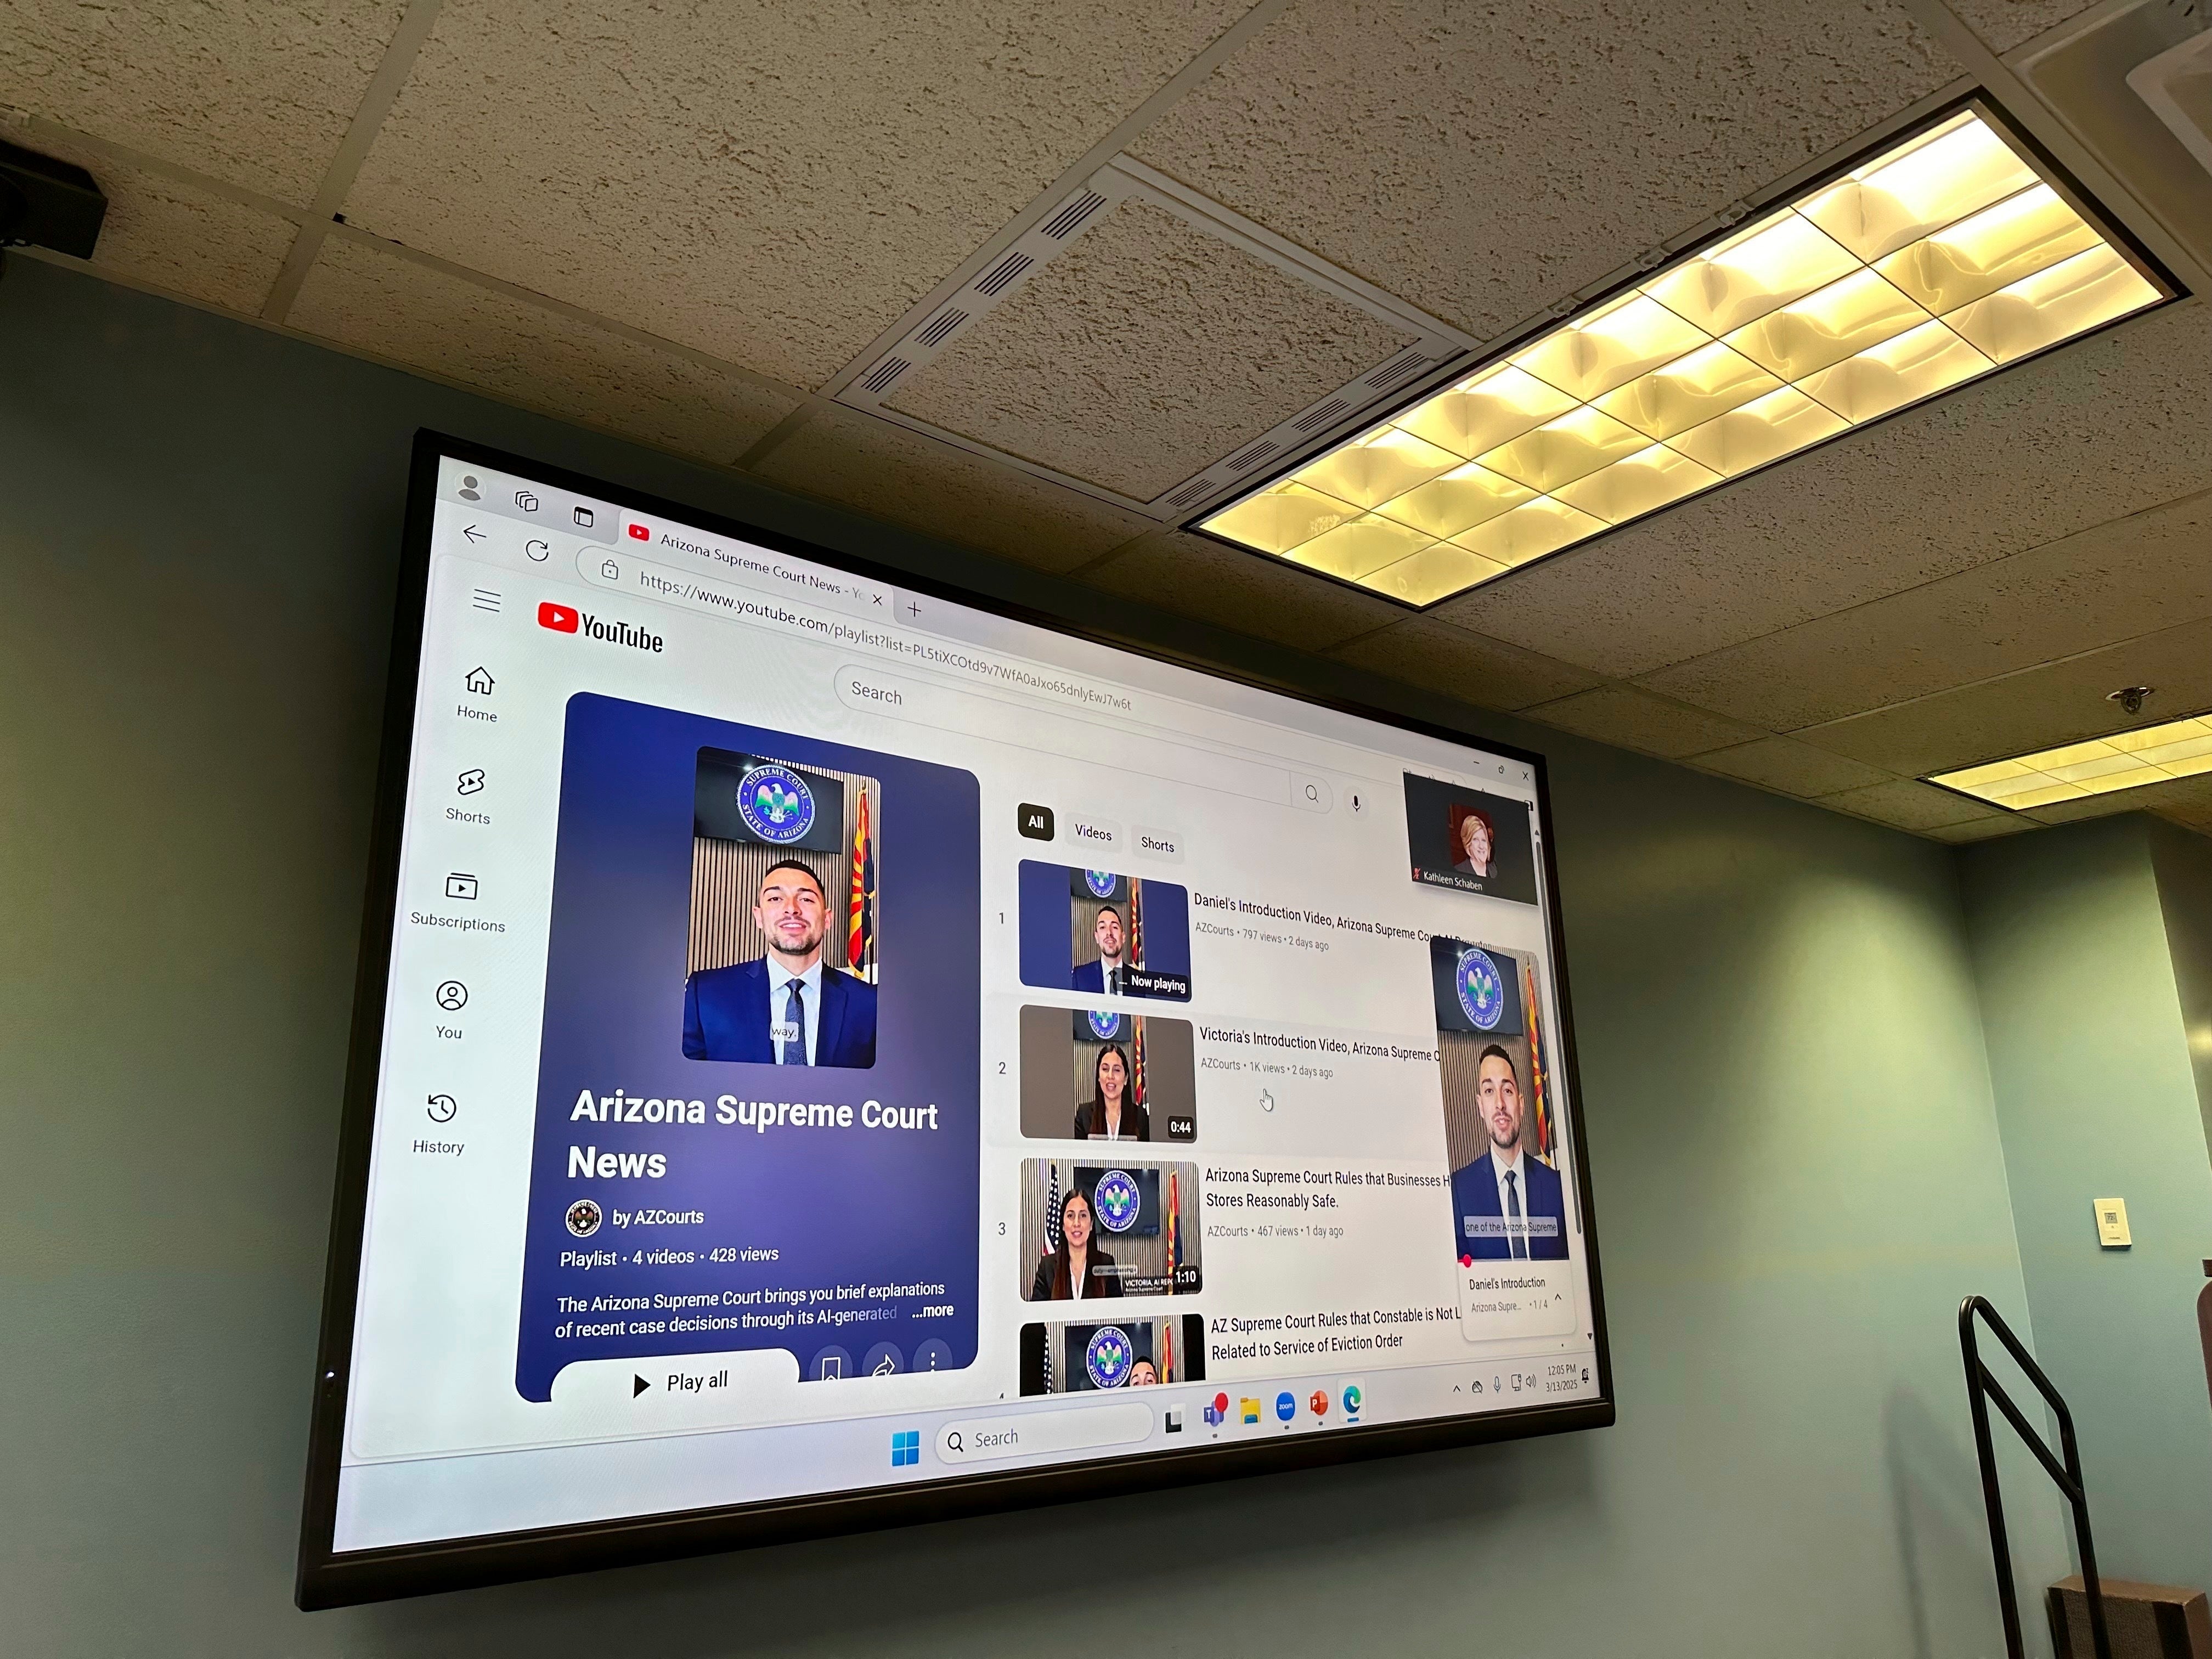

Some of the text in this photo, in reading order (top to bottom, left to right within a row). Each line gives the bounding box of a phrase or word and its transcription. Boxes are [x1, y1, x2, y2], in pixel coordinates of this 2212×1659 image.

[661, 534, 710, 557] Arizona
[715, 549, 769, 574] Supreme
[773, 566, 806, 585] Court
[810, 575, 840, 595] News
[582, 612, 663, 653] YouTube
[852, 681, 902, 706] Search
[457, 704, 498, 723] Home
[746, 768, 809, 800] SUPREME COURT
[445, 808, 490, 825] Shorts
[742, 804, 809, 839] STATE OF ARIZONA
[1028, 815, 1044, 829] All
[1075, 823, 1112, 841] Videos
[1141, 837, 1175, 853] Shorts
[1424, 871, 1483, 891] Kathleen Schaben
[410, 912, 506, 933] Subscriptions
[999, 912, 1005, 924] 1
[1194, 893, 1236, 911] Daniel's
[1239, 900, 1301, 922] Introduction
[1304, 911, 1334, 929] Video,
[1337, 917, 1373, 933] Arizona
[1375, 923, 1415, 941] Supreme
[1195, 922, 1329, 952] AZCourts 797 views 2 days ago
[1460, 952, 1498, 982] SUPREME COURT
[1131, 975, 1186, 994] Now playing
[1460, 991, 1501, 1024] STATE OF ARIZONA
[436, 1025, 462, 1039] You
[771, 1029, 796, 1039] way.
[1199, 1026, 1250, 1045] Victoria's
[1254, 1031, 1316, 1051] Introduction
[1319, 1039, 1350, 1054] Video,
[1352, 1043, 1389, 1057] Arizona
[1391, 1046, 1432, 1062] Supreme
[998, 1062, 1006, 1074] 2
[1201, 1058, 1334, 1079] AZCourts 1K views 2 days ago
[569, 1089, 939, 1133] Arizona Supreme Court
[1171, 1121, 1191, 1133] 0:44
[413, 1140, 465, 1156] History
[567, 1146, 667, 1178] News
[1206, 1168, 1249, 1182] Arizona
[1252, 1170, 1301, 1186] Supreme
[1304, 1171, 1333, 1184] Court
[1335, 1171, 1363, 1185] Rules
[1365, 1172, 1386, 1186] that
[1387, 1173, 1441, 1187] Businesses
[1206, 1193, 1339, 1210] Stores Reasonably Safe.
[613, 1209, 631, 1229] by
[634, 1210, 704, 1225] AZCourts
[998, 1222, 1006, 1235] 3
[1465, 1222, 1556, 1234] one of the Arizona Supreme
[1207, 1224, 1344, 1239] AZCourts 467 views 1 day ago
[560, 1246, 780, 1271] Playlist 4 videos 428 views
[1176, 1271, 1197, 1283] 1:10
[1469, 1277, 1545, 1290] Daniel's Introduction
[557, 1282, 945, 1313] The Arizona Supreme Court brings you brief explanations
[912, 1304, 955, 1318] ...more
[1471, 1302, 1497, 1313] Arizona
[555, 1305, 898, 1338] of recent case decisions through its AI-generated
[1211, 1319, 1228, 1333] AZ
[1231, 1317, 1282, 1335] Supreme
[1285, 1314, 1315, 1329] Court
[1318, 1313, 1347, 1327] Rules
[1350, 1311, 1371, 1325] that
[1374, 1308, 1423, 1323] Constable
[1425, 1308, 1434, 1320] is
[1436, 1306, 1454, 1320] Not
[1212, 1334, 1403, 1360] Related to Service of Eviction Order
[1548, 1364, 1576, 1375] 12:05 PM
[667, 1371, 728, 1393] Play all
[1546, 1380, 1578, 1392] 3/13/2025
[1312, 1399, 1318, 1408] P
[975, 1428, 1018, 1447] Search
